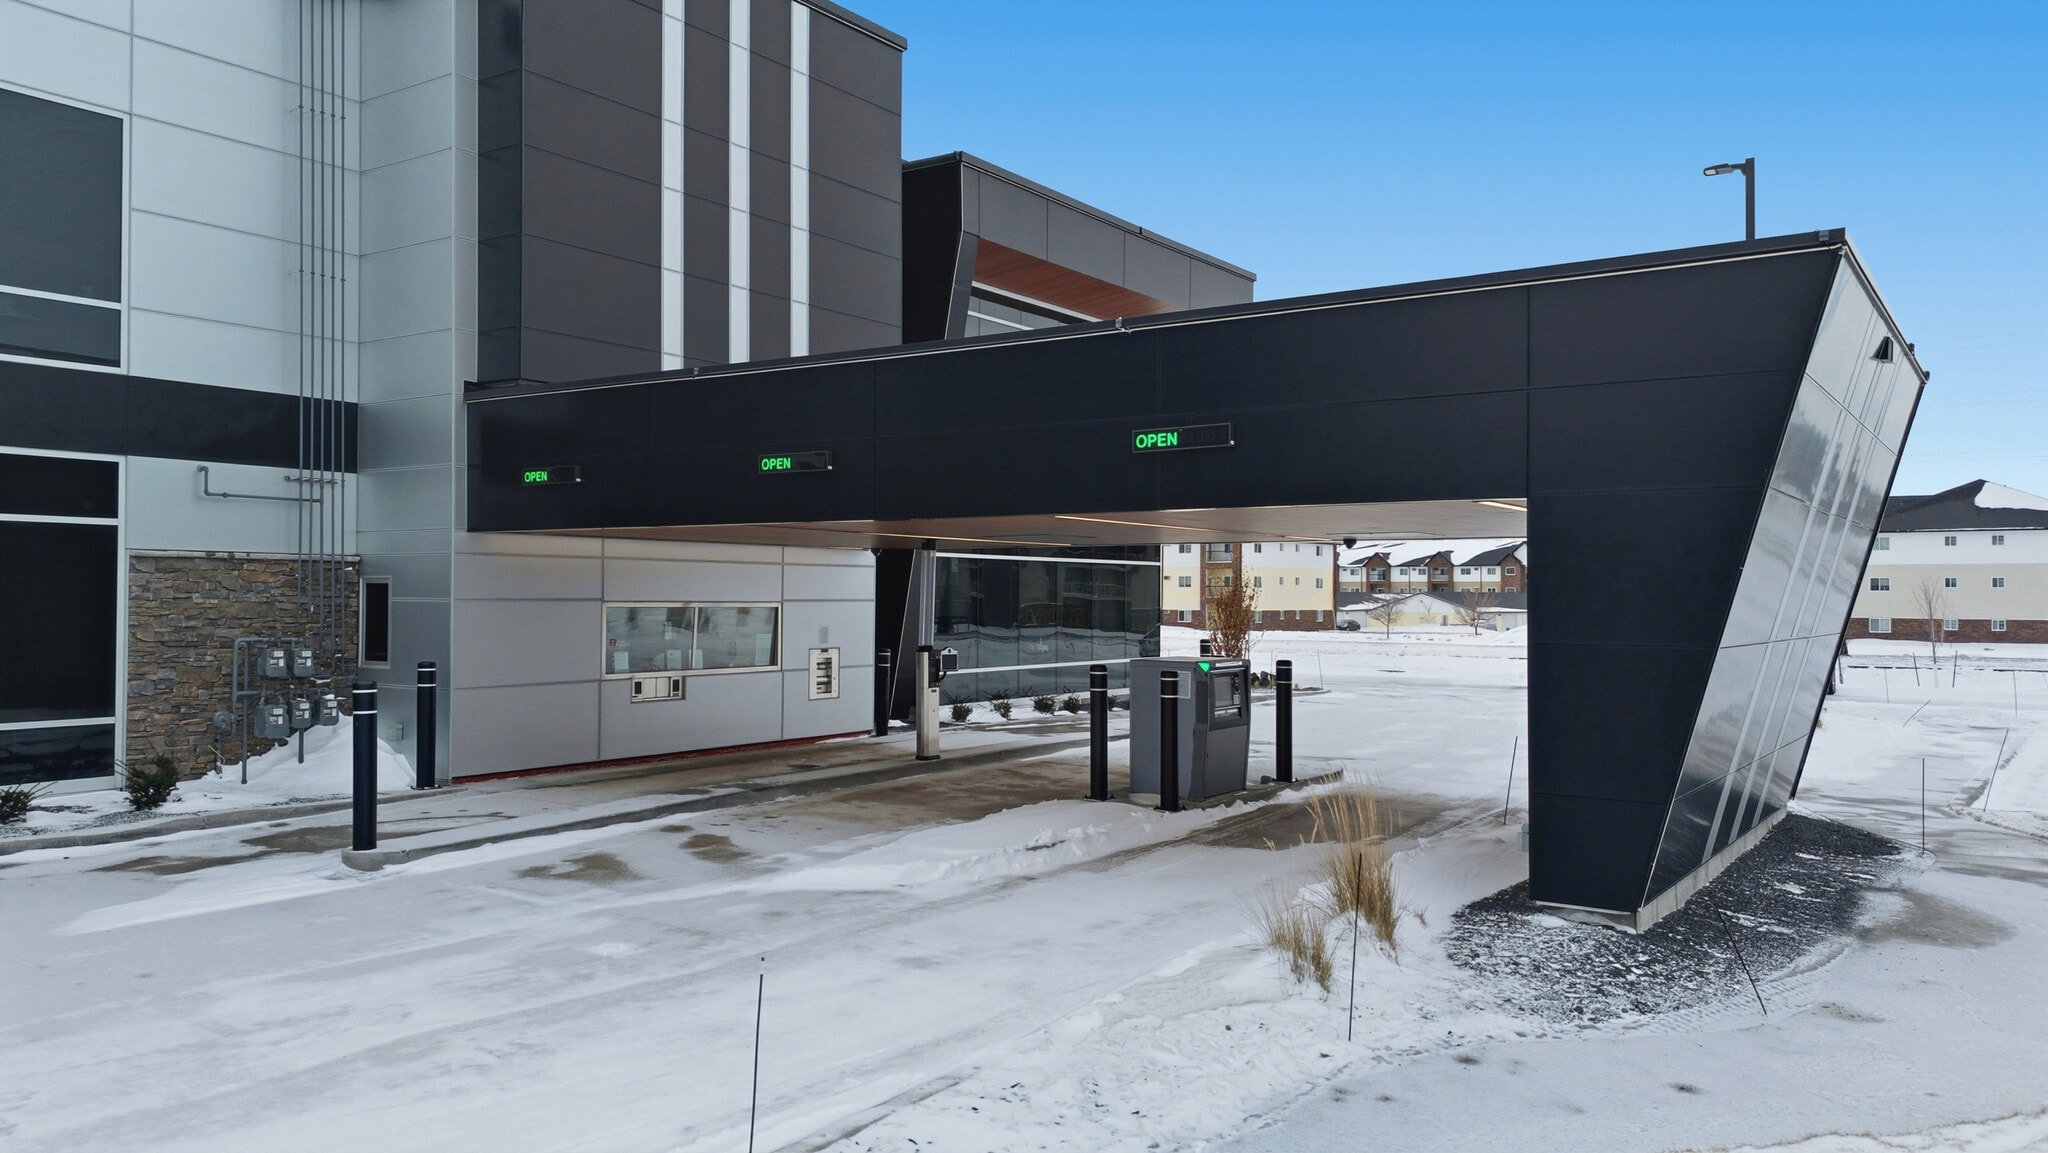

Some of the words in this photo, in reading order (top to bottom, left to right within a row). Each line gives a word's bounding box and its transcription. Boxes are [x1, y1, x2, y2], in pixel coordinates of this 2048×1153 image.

[1135, 432, 1178, 449] OPEN
[761, 457, 791, 470] OPEN
[524, 471, 548, 483] OPEN
